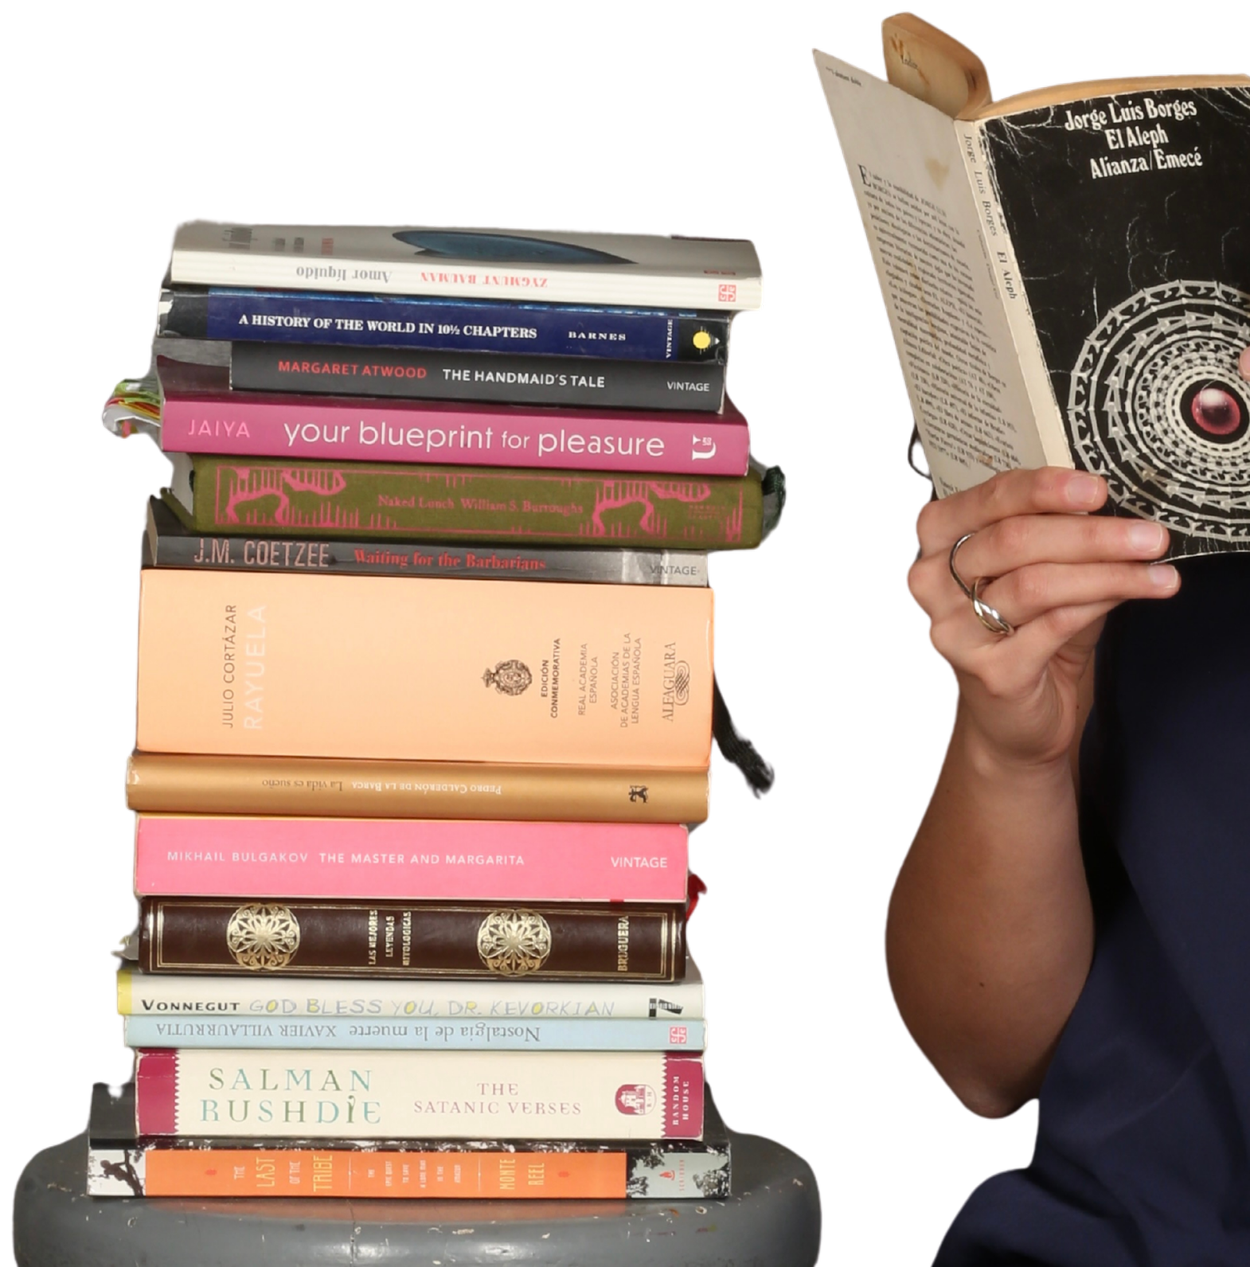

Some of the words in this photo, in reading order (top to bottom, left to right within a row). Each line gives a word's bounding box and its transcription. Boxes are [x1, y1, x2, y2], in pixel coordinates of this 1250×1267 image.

[1064, 109, 1107, 131] Jorge
[1108, 100, 1144, 123] Luis
[1143, 98, 1197, 121] Borges
[1104, 128, 1125, 150] El
[1126, 123, 1169, 148] Aleph
[964, 133, 977, 163] Jorge
[974, 170, 986, 195] Luis
[982, 200, 998, 237] Borges
[296, 265, 347, 282] líquido
[352, 269, 393, 284] Amor
[420, 272, 476, 285] BAUMAN
[482, 275, 548, 288] ZYGMUNT
[996, 250, 1008, 264] El
[1002, 268, 1018, 300] Aleph
[239, 314, 249, 325] A
[252, 315, 311, 328] HISTORY
[313, 318, 333, 329] OF
[335, 319, 364, 331] THE
[367, 321, 415, 333] WORLD
[418, 323, 434, 334] IN
[463, 325, 537, 339] CHAPTERS
[568, 331, 626, 341] BARNES
[665, 319, 674, 359] VINTAGE
[278, 361, 359, 375] MARGARET
[361, 365, 427, 379] ATWOOD
[442, 368, 471, 381] THE
[474, 369, 567, 386] HANDMAID'S
[570, 375, 605, 388] TALE
[667, 381, 710, 392] VINTAGE
[188, 419, 250, 438] JAIYA
[284, 422, 350, 447] your
[359, 420, 493, 452] blueprint
[501, 429, 530, 449] for
[538, 429, 664, 458] pleasure
[378, 494, 416, 508] Naked
[418, 497, 455, 510] Lunch
[460, 497, 507, 511] William
[508, 499, 519, 512] S.
[522, 500, 584, 517] Burroughs
[194, 538, 235, 563] J.M.
[243, 540, 329, 567] COETZEE
[354, 548, 408, 568] Waiting
[412, 551, 434, 567] for
[438, 551, 461, 567] the
[465, 552, 547, 571] Barbarians
[650, 564, 697, 577] VINTAGE
[222, 604, 236, 684] CORTÁZAR
[623, 632, 631, 643] LA
[622, 646, 631, 660] DE
[632, 637, 642, 686] ESPAÑOLA
[244, 605, 267, 730] RAYUELA
[579, 643, 588, 692] ACADEMIA
[540, 659, 549, 698] EDICIÓN
[550, 638, 561, 719] CONMEMORATIVA
[588, 656, 598, 704] ESPAÑOLA
[610, 651, 620, 710] ASOCIACIÓN
[621, 661, 630, 715] ACADEMIAS
[662, 642, 676, 722] ALFAGUARA
[222, 688, 235, 729] JULIO
[578, 693, 587, 716] REAL
[631, 688, 640, 724] LENGUA
[620, 716, 628, 728] DE
[262, 779, 290, 789] sueño
[307, 780, 328, 791] vida
[330, 781, 343, 791] La
[351, 781, 382, 791] BARCA
[385, 782, 397, 790] LA
[414, 784, 468, 795] CALDERÓN
[470, 785, 502, 794] PEDRO
[167, 851, 224, 862] MIKHAIL
[232, 852, 308, 863] BULGAKOV
[319, 853, 345, 863] THE
[351, 853, 405, 864] MASTER
[410, 854, 439, 865] AND
[445, 855, 525, 866] MARGARITA
[611, 857, 668, 868] VINTAGE
[368, 910, 378, 948] MEJORES
[385, 916, 395, 958] LEYENDAS
[617, 916, 630, 972] BRUGUERA
[368, 950, 377, 965] LAS
[141, 999, 240, 1012] VONNEGUT
[249, 999, 297, 1013] GOD
[306, 998, 383, 1015] BLESS
[391, 1000, 439, 1016] YOU,
[447, 1000, 482, 1016] DR.
[490, 1000, 615, 1016] KEVORKIAN
[156, 1023, 274, 1037] VILLAURRUTIA
[278, 1024, 337, 1038] XAVIER
[349, 1024, 408, 1036] muerte
[415, 1026, 428, 1040] la
[435, 1026, 454, 1040] de
[461, 1022, 540, 1043] Nostalgia
[208, 1068, 372, 1092] SALMAN
[477, 1083, 519, 1096] THE
[200, 1095, 382, 1124] RUSHDIE
[413, 1101, 500, 1114] SATANIC
[509, 1102, 582, 1115] VERSES
[672, 1076, 680, 1126] RANDOM
[682, 1081, 690, 1121] HOUSE
[255, 1157, 276, 1187] LAST
[313, 1155, 333, 1192] TRIBE
[500, 1159, 516, 1190] MONTE
[528, 1163, 545, 1186] REEL
